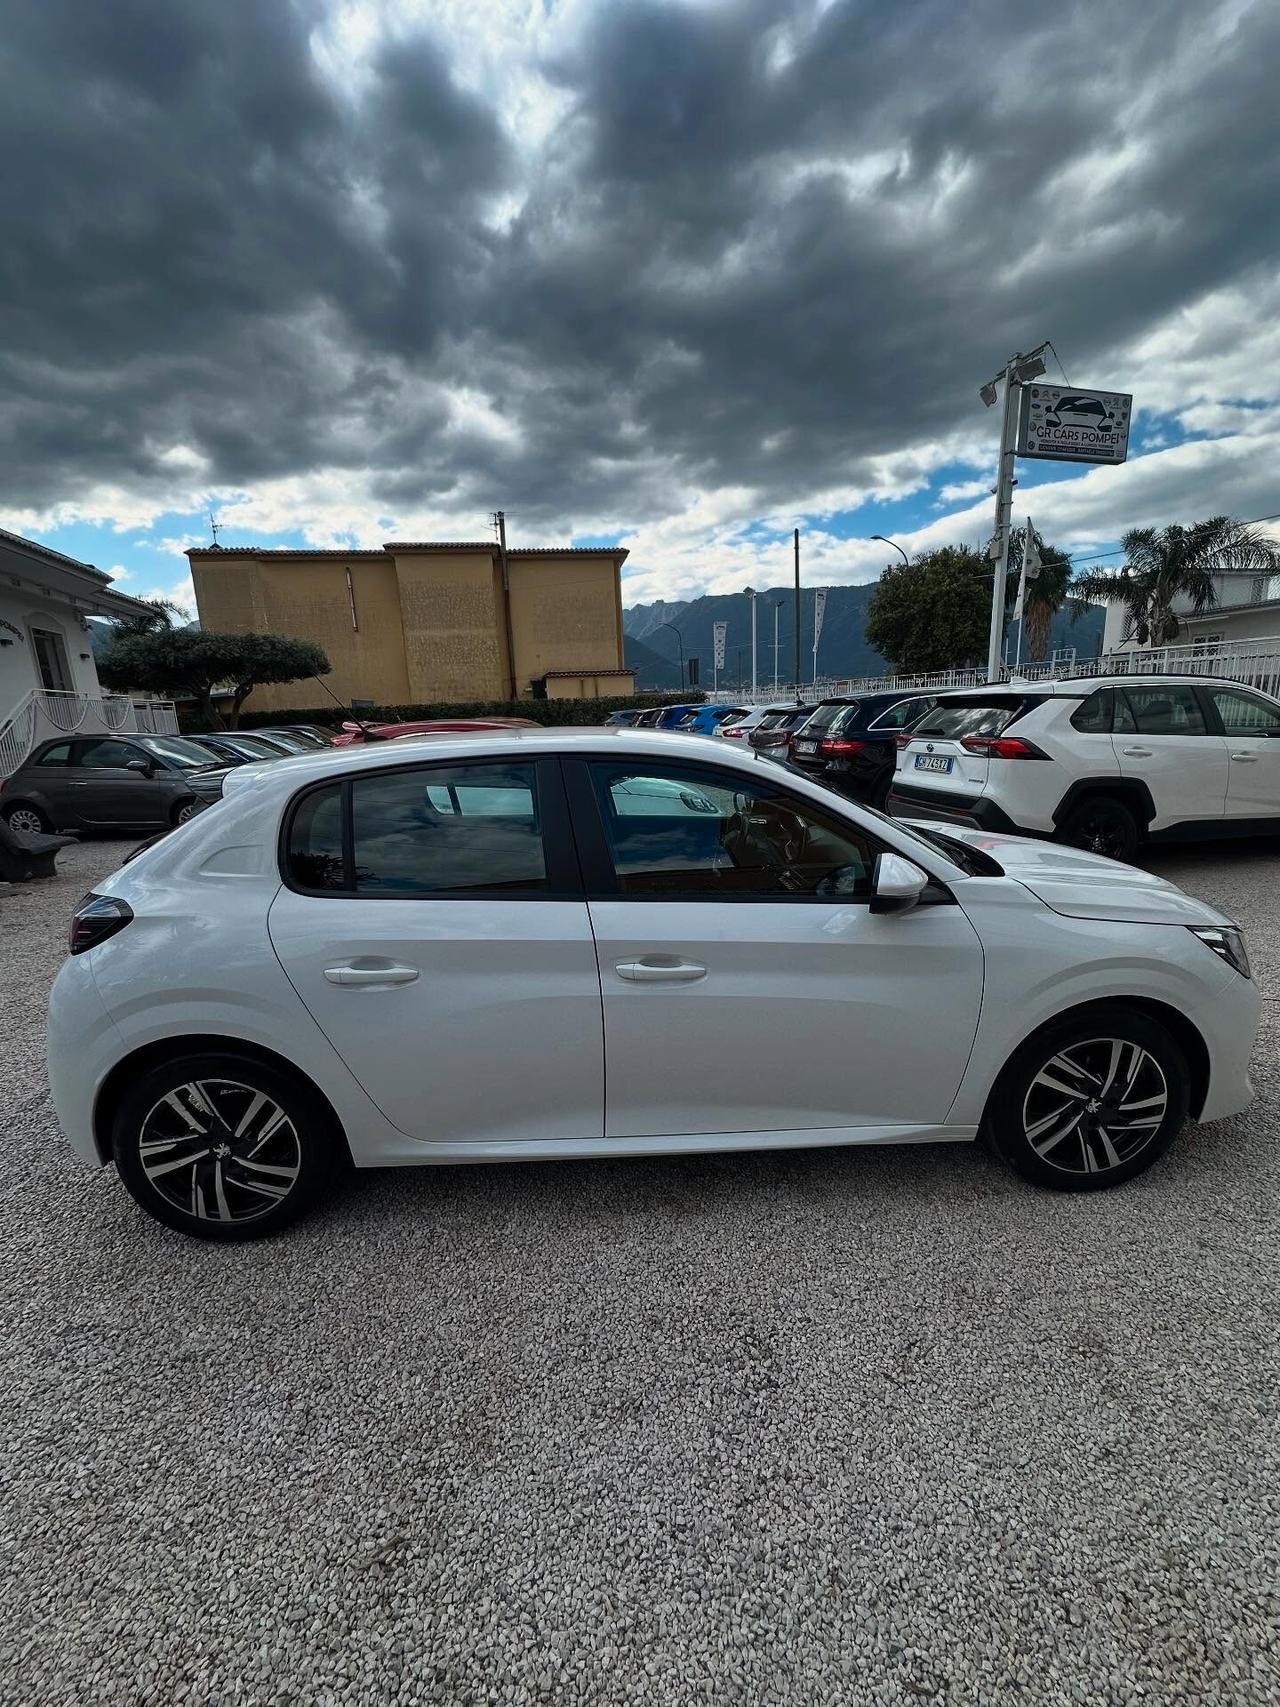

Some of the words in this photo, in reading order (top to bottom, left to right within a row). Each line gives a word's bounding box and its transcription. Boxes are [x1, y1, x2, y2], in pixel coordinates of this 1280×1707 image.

[1036, 425, 1051, 438] GR
[1053, 428, 1080, 441] CARS
[1081, 432, 1120, 444] POMPEI
